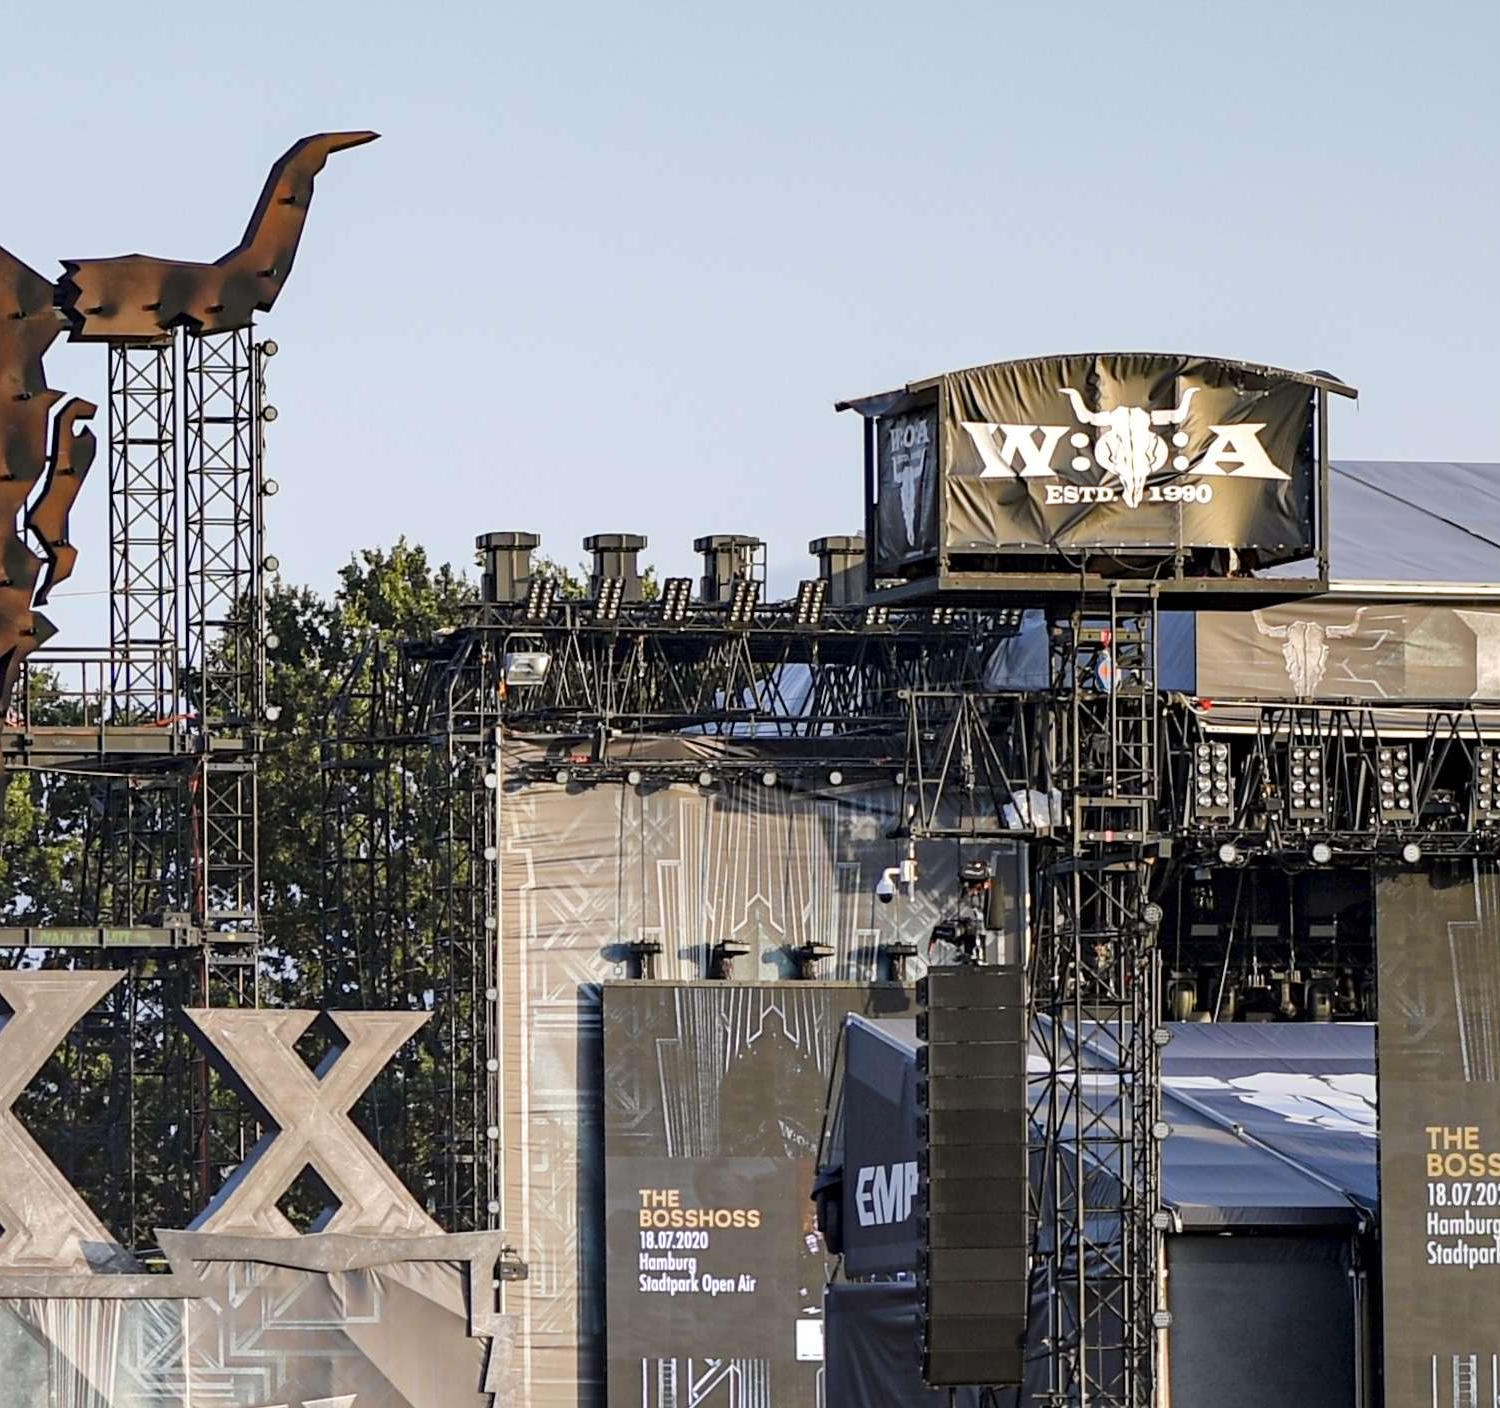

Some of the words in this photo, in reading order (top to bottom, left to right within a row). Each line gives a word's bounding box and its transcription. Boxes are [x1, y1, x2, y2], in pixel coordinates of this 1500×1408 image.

[1045, 485, 1118, 504] ESTD.
[1150, 485, 1212, 503] 1990
[1426, 1127, 1479, 1149] THE
[639, 1190, 679, 1207] THE
[855, 1161, 919, 1226] EMP
[640, 1210, 760, 1227] BOSSHOSS
[640, 1232, 708, 1249] 18.07.2020
[639, 1251, 696, 1275] Hamburg
[639, 1273, 699, 1296] Stadtpark
[702, 1275, 734, 1296] Open
[738, 1275, 756, 1291] Air
